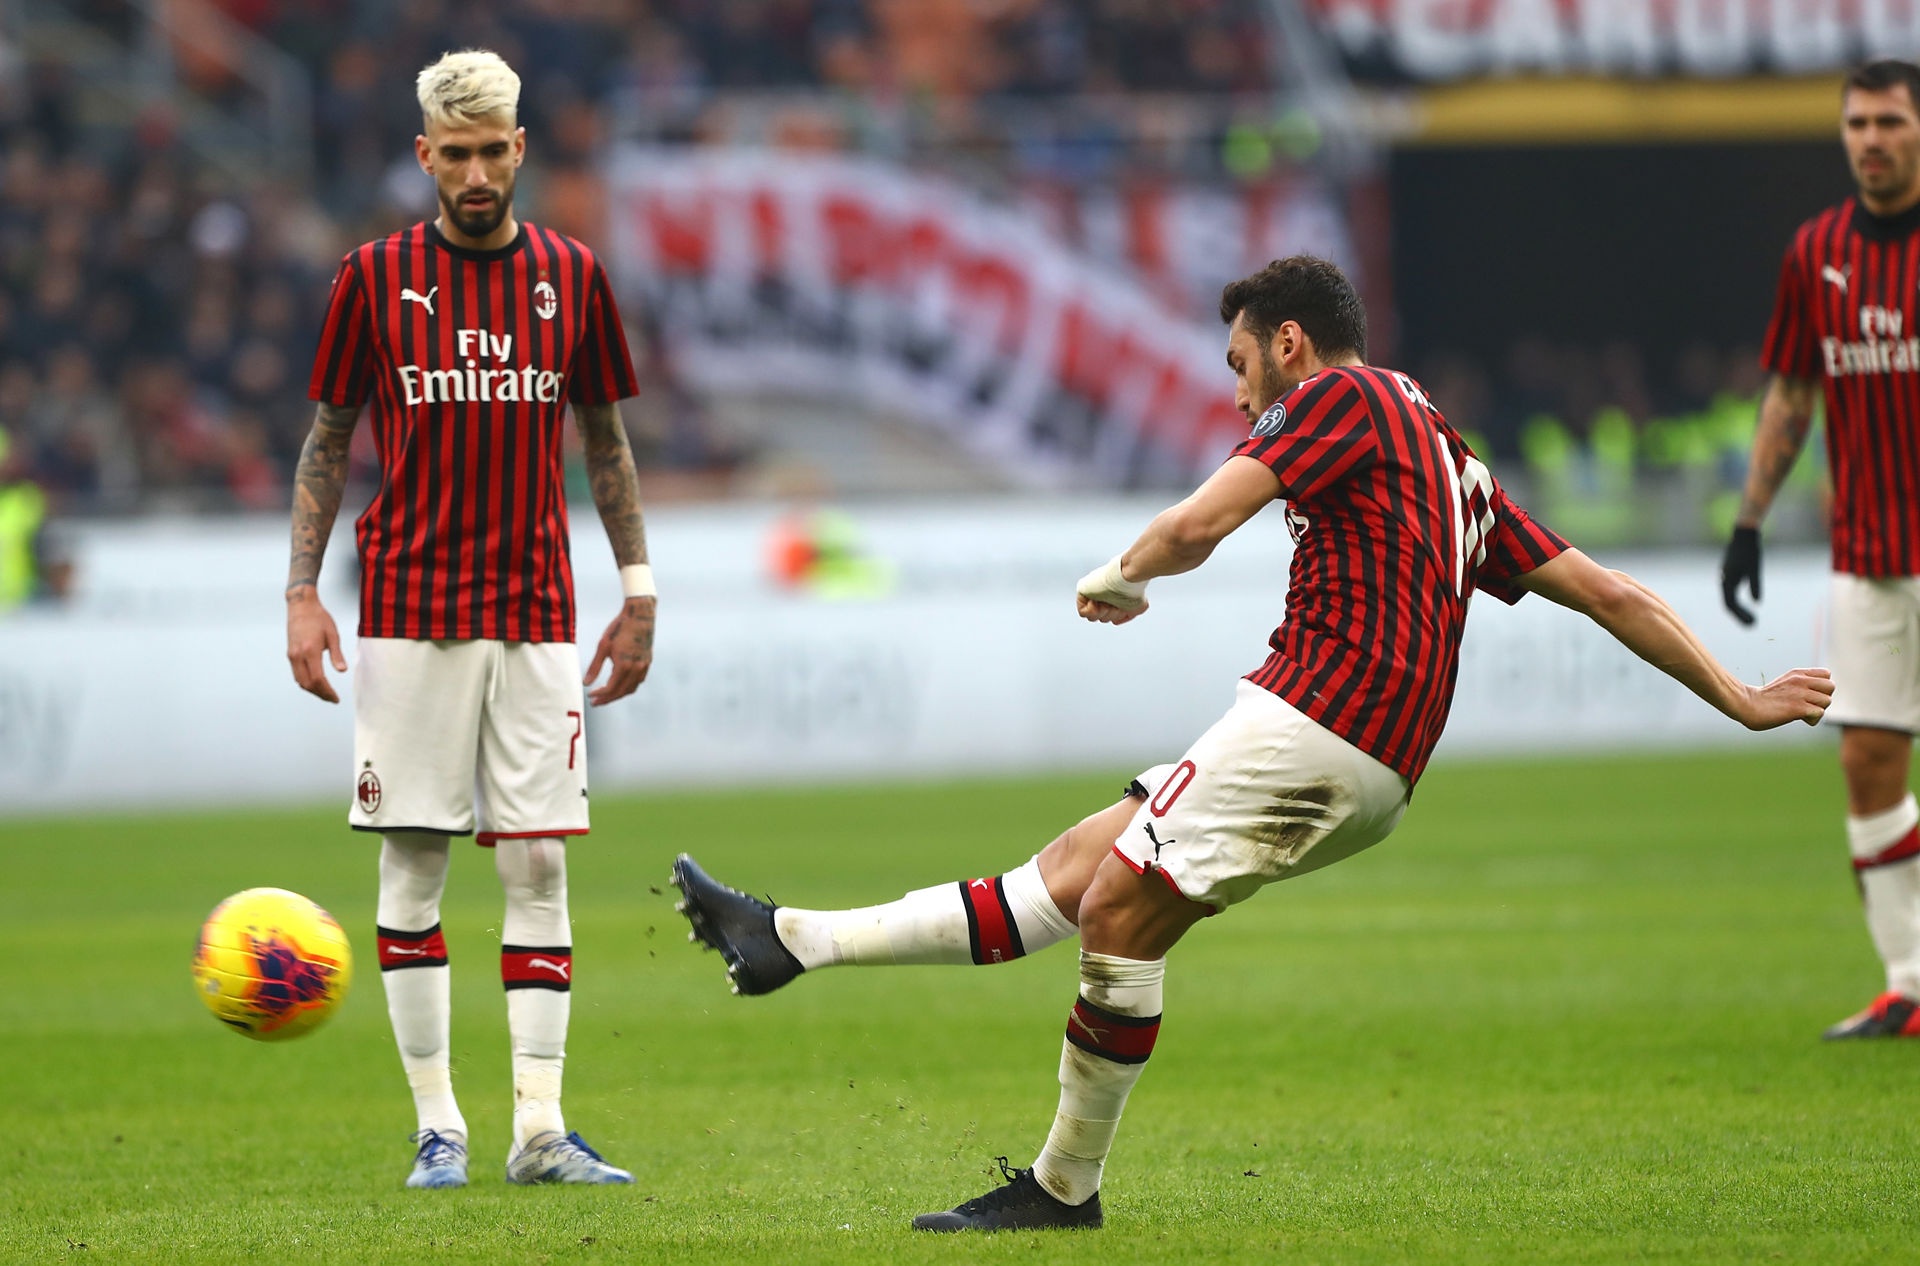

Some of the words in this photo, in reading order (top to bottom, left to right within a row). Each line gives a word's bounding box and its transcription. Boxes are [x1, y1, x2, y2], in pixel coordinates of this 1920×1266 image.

[1860, 304, 1903, 337] Fly
[457, 328, 512, 362] Fly
[397, 359, 564, 405] Emirates
[566, 710, 581, 770] 7
